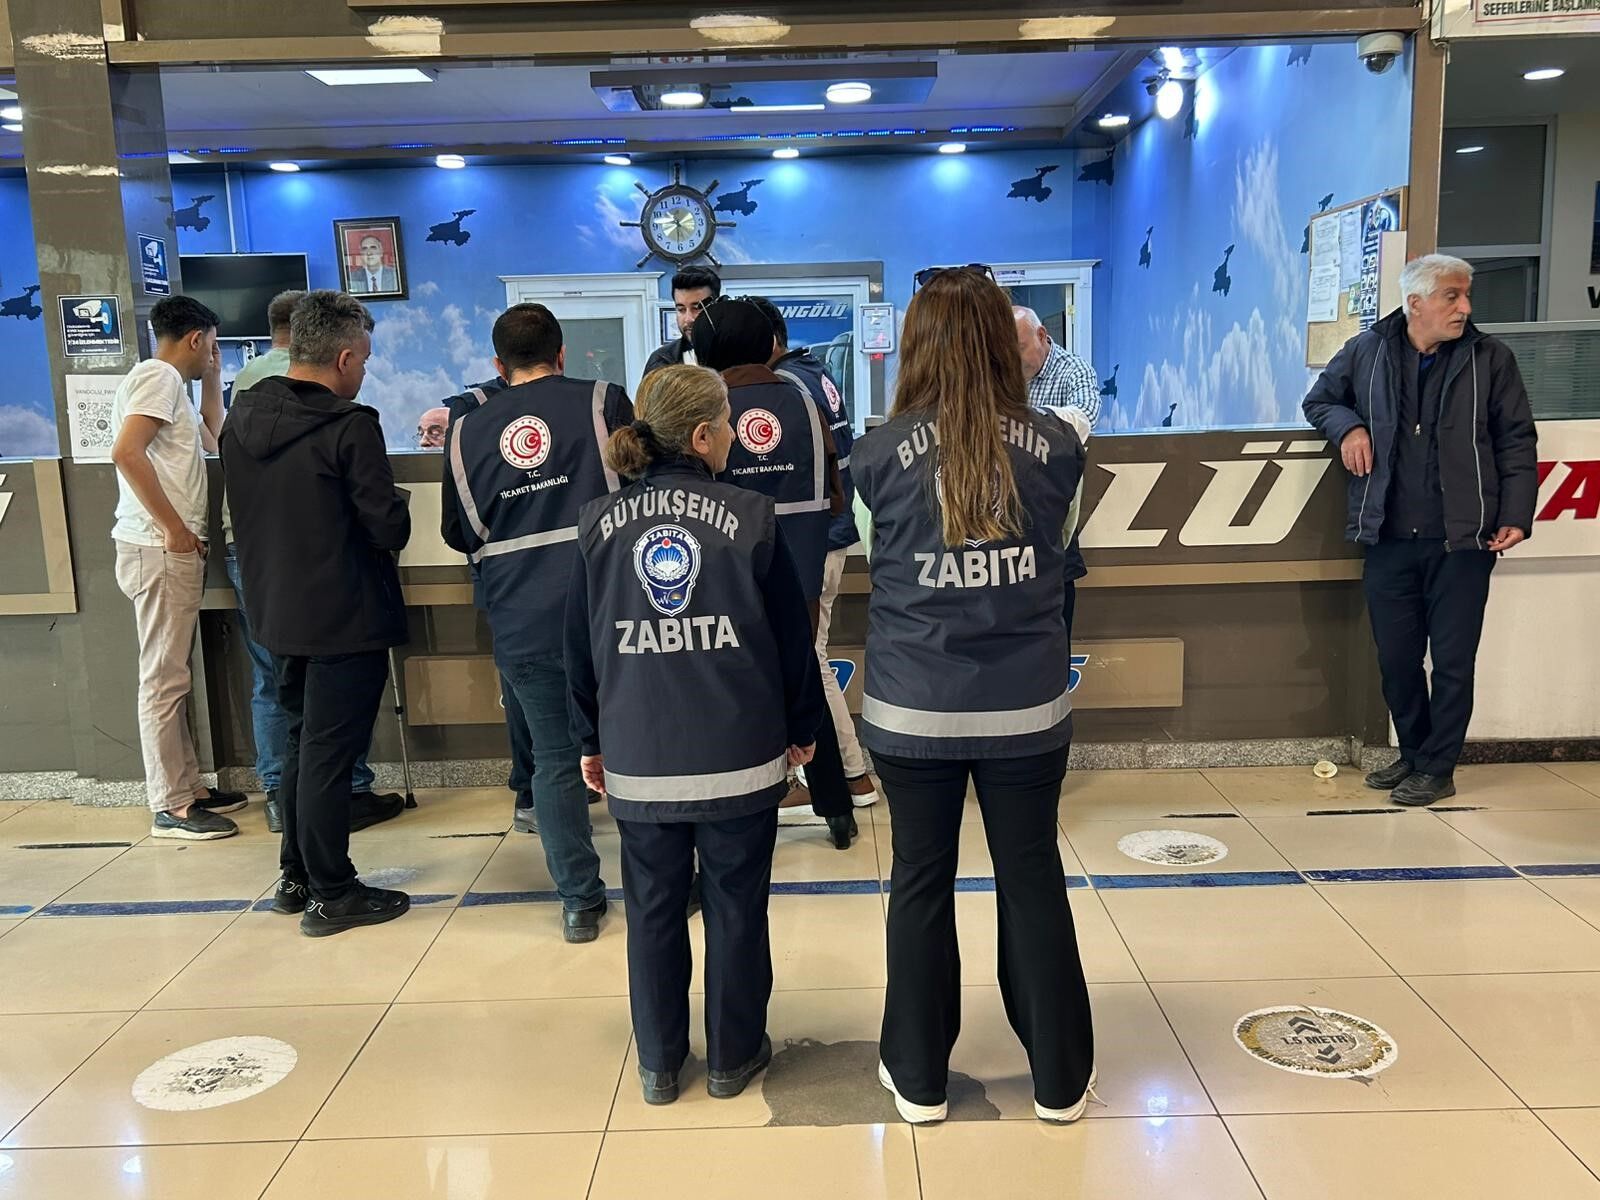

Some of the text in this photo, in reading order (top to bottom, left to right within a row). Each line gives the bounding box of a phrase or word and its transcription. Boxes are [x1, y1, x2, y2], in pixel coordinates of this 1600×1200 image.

[1483, 0, 1550, 16] SEFERLERİNE
[660, 201, 668, 209] 11
[671, 196, 681, 205] 12
[686, 199, 690, 207] 1
[694, 207, 700, 215] 2
[698, 218, 704, 226] 3
[656, 233, 663, 241] 8
[665, 242, 671, 250] 7
[677, 243, 684, 251] 6
[689, 240, 695, 248] 5
[896, 415, 1050, 471] BÜYEHİR
[758, 454, 769, 462] T.C.
[526, 469, 541, 479] T.C.
[732, 463, 795, 476] TİCARET BAKANLIĞI
[500, 475, 569, 499] TİCARET BAKANLIĞI
[1078, 440, 1333, 549] LÜ
[600, 486, 739, 541] BÜYÜKŞEHİR
[649, 529, 684, 541] ZABITA
[914, 545, 1037, 588] ZABITA
[615, 615, 740, 654] ZABITA
